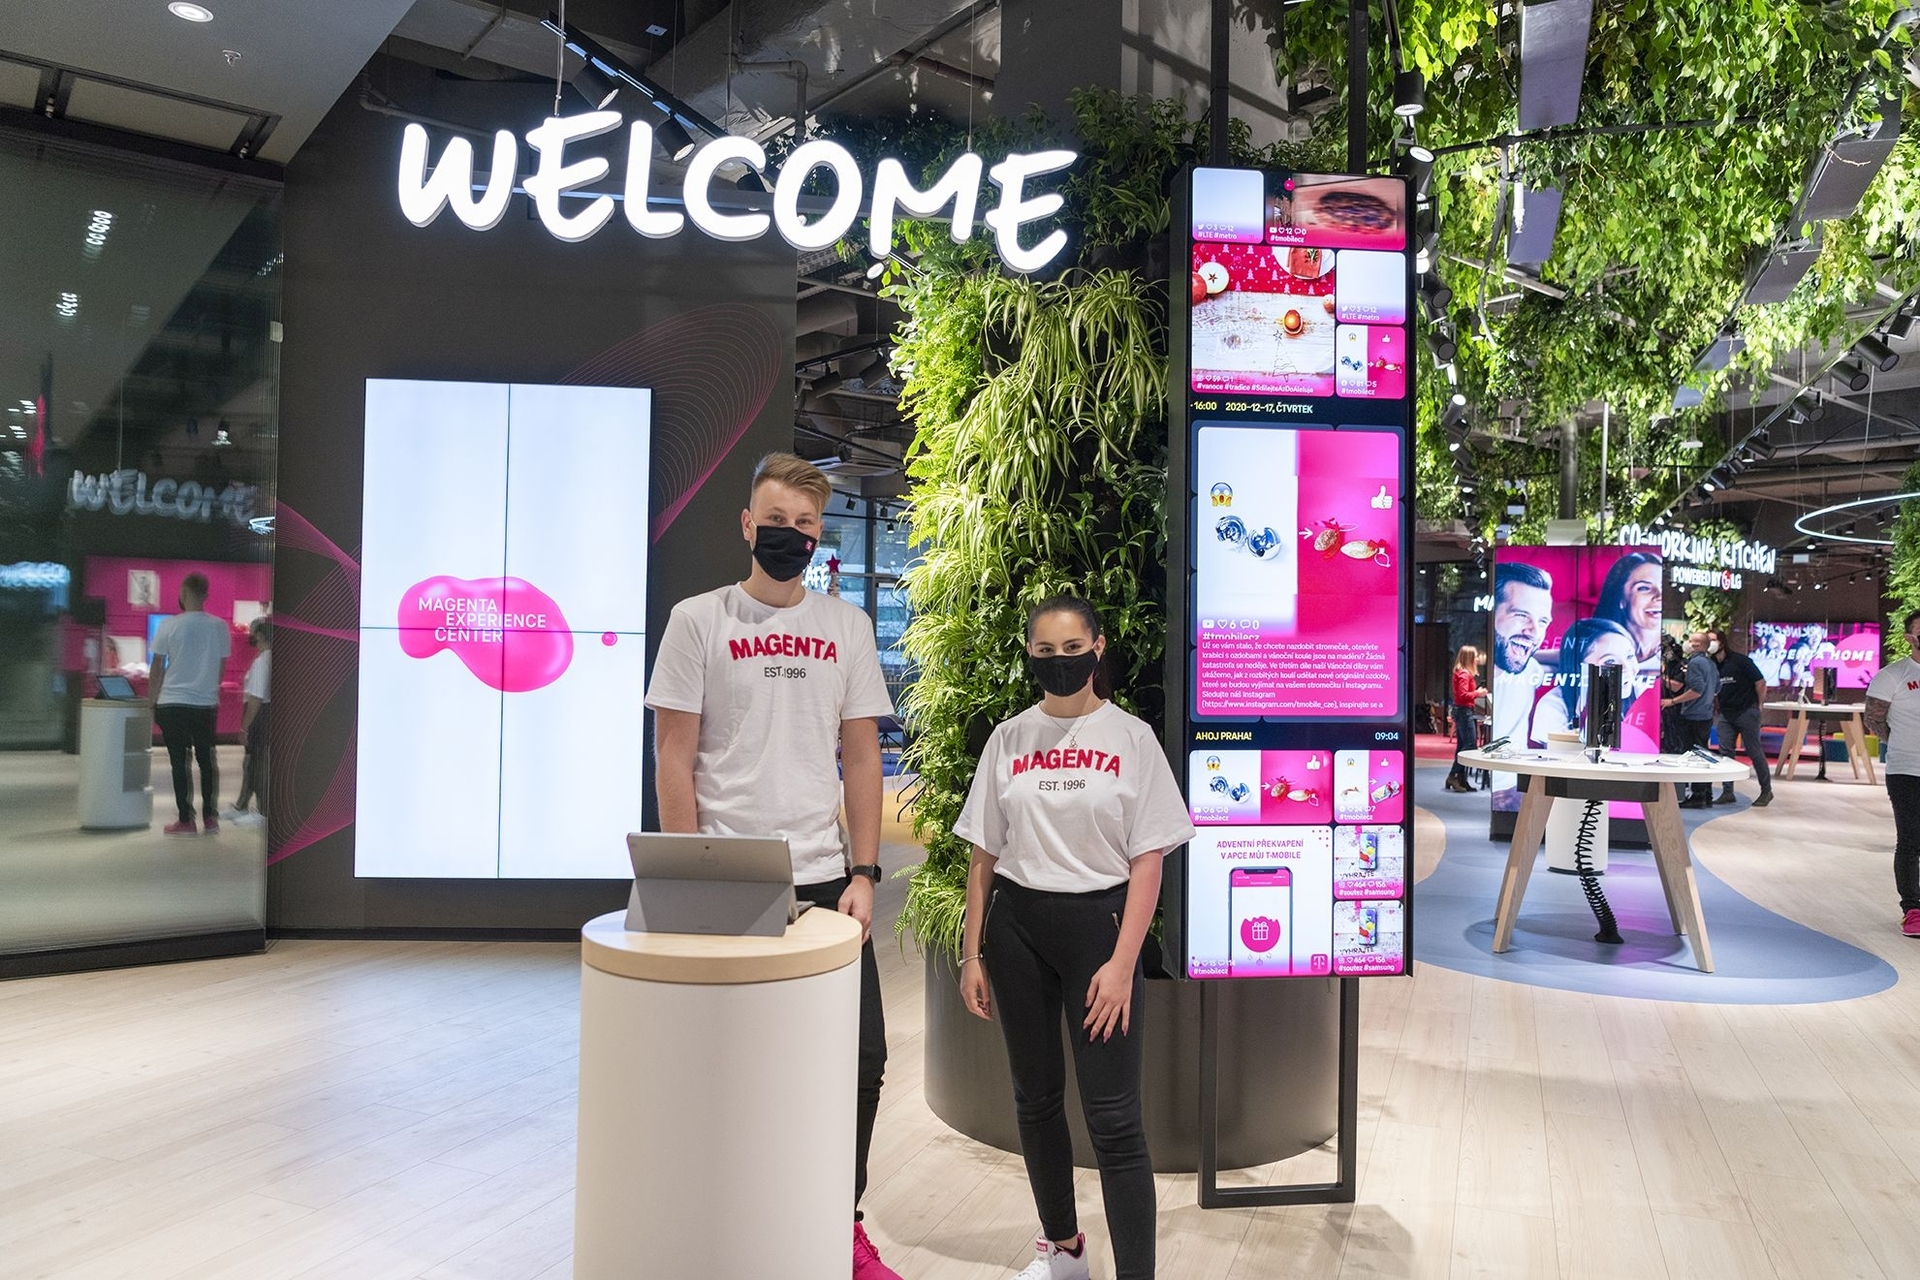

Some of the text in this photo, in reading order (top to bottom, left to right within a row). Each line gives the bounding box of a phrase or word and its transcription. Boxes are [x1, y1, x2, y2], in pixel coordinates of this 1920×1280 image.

[398, 110, 1078, 274] WELCOME
[1270, 235, 1304, 244] #tmobilecz
[1719, 539, 1776, 575] KITCHEN
[801, 562, 830, 591] AFÉ
[1672, 566, 1711, 587] POWERED
[1711, 570, 1723, 588] BY
[418, 597, 498, 612] MAGENTA
[446, 612, 546, 628] EXPERIENCE
[1230, 620, 1260, 630] 6 0
[434, 627, 504, 642] CENTER
[728, 633, 837, 664] MAGENTA
[1312, 652, 1326, 660] jsou
[1829, 650, 1874, 662] HOME
[1196, 732, 1252, 740] AHOJ PRAHA!
[1374, 732, 1398, 741] 09:04
[1012, 748, 1120, 778] MAGENTA
[1038, 780, 1086, 791] EST. 1996
[1194, 814, 1229, 822] #tmobilecz
[1216, 838, 1304, 848] ADVENTNÍ PŘEKVAPENÍ
[1227, 852, 1248, 860] APCE
[1266, 851, 1301, 859] T-MOBILE
[1364, 889, 1396, 897] #samsung
